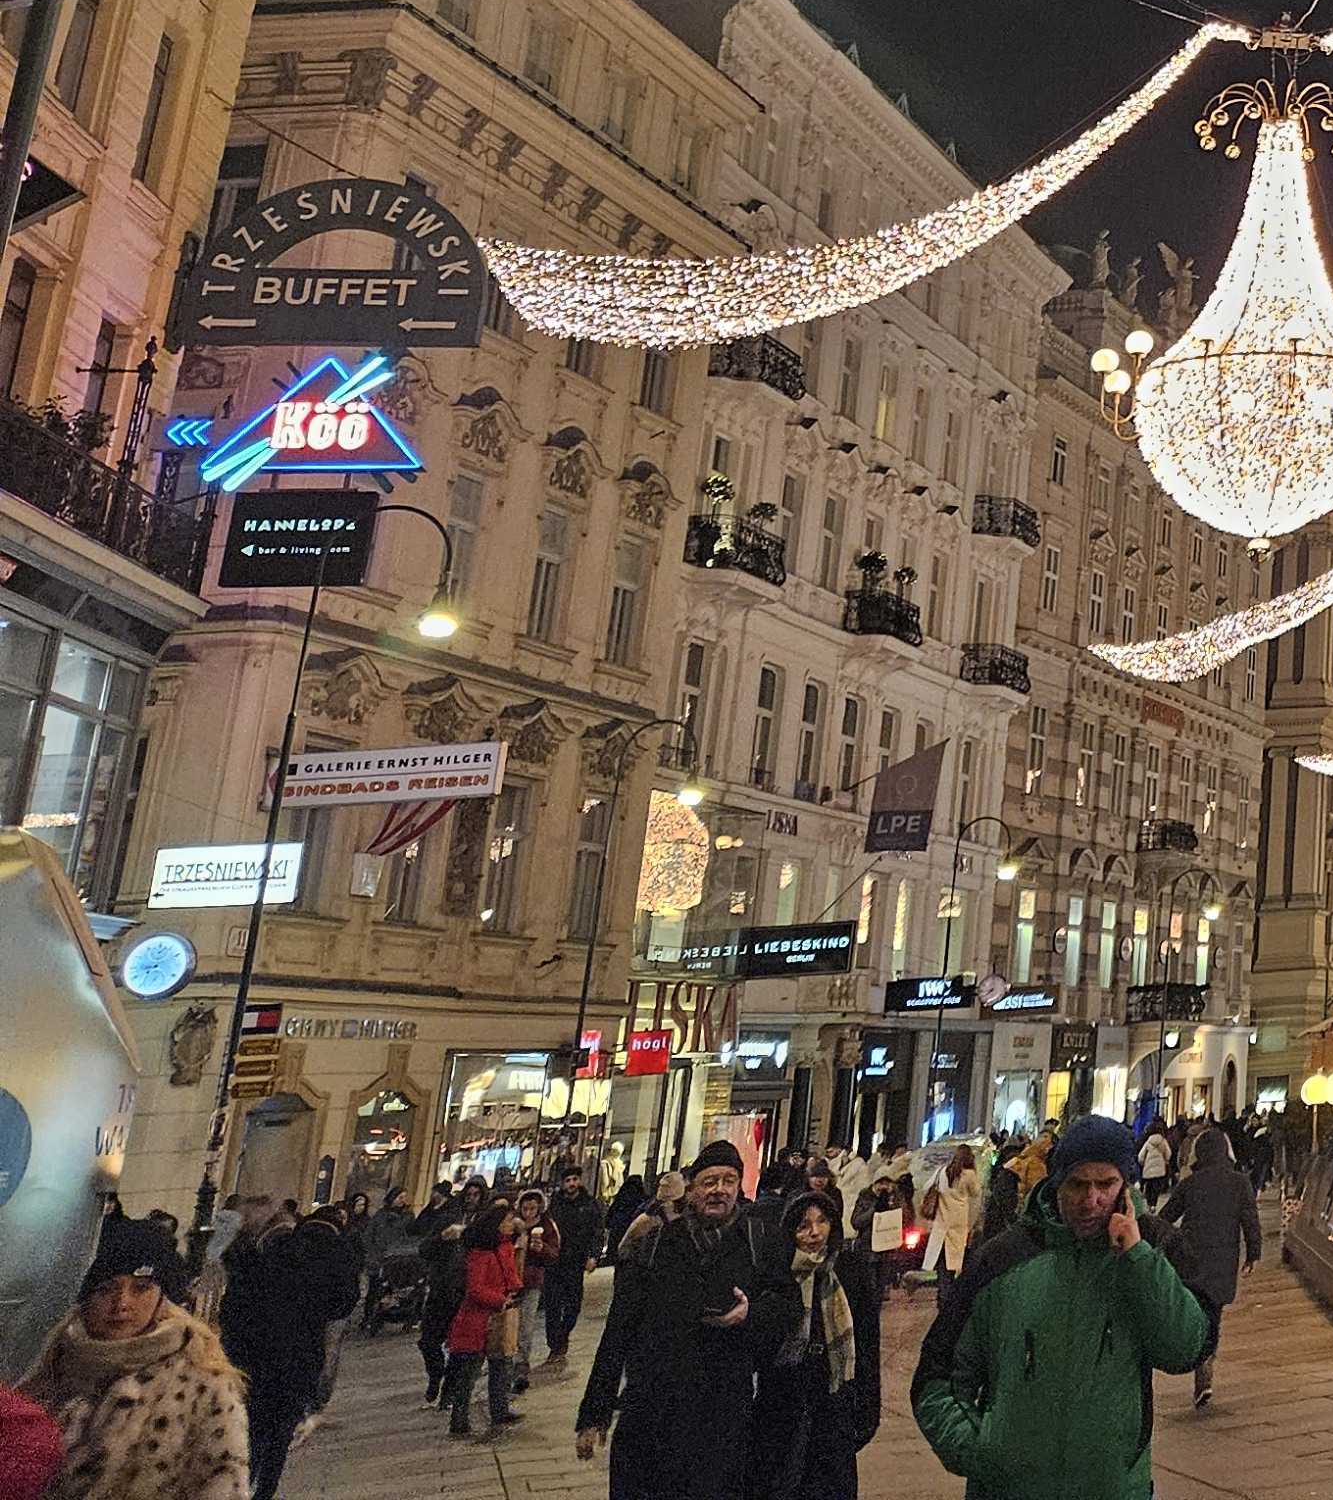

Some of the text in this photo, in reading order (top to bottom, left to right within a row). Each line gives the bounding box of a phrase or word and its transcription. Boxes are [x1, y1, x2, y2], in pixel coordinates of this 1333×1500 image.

[253, 276, 417, 306] BUFFET
[304, 753, 492, 773] GALERIE ERNST HILGER
[407, 774, 489, 791] REISEN
[163, 860, 289, 884] TRZEŚNIEWKI
[754, 936, 850, 954] LIEBESKIND
